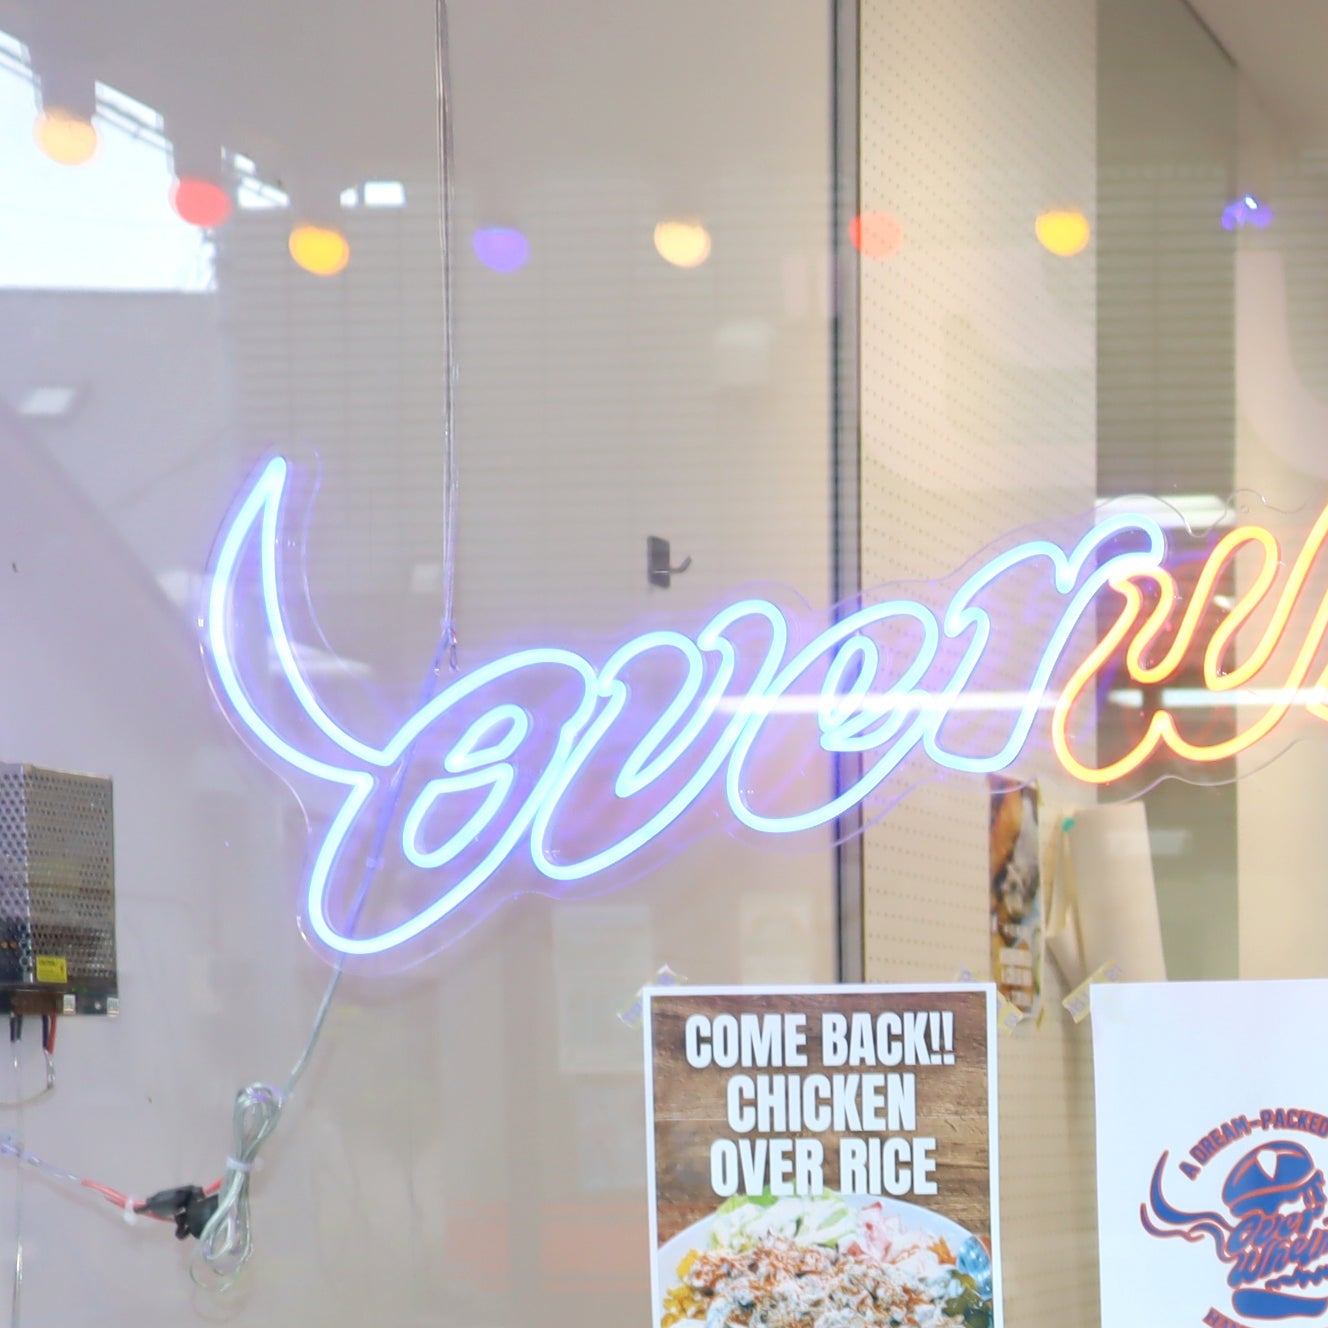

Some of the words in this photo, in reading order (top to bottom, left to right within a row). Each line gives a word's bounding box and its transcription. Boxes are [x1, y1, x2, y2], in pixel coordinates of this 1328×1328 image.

[685, 1013, 808, 1069] COME
[822, 1011, 956, 1066] BACK!!
[726, 1074, 917, 1133] CHICKEN
[709, 1139, 826, 1196] OVER
[839, 1138, 938, 1195] RICE
[1179, 1161, 1202, 1181] A
